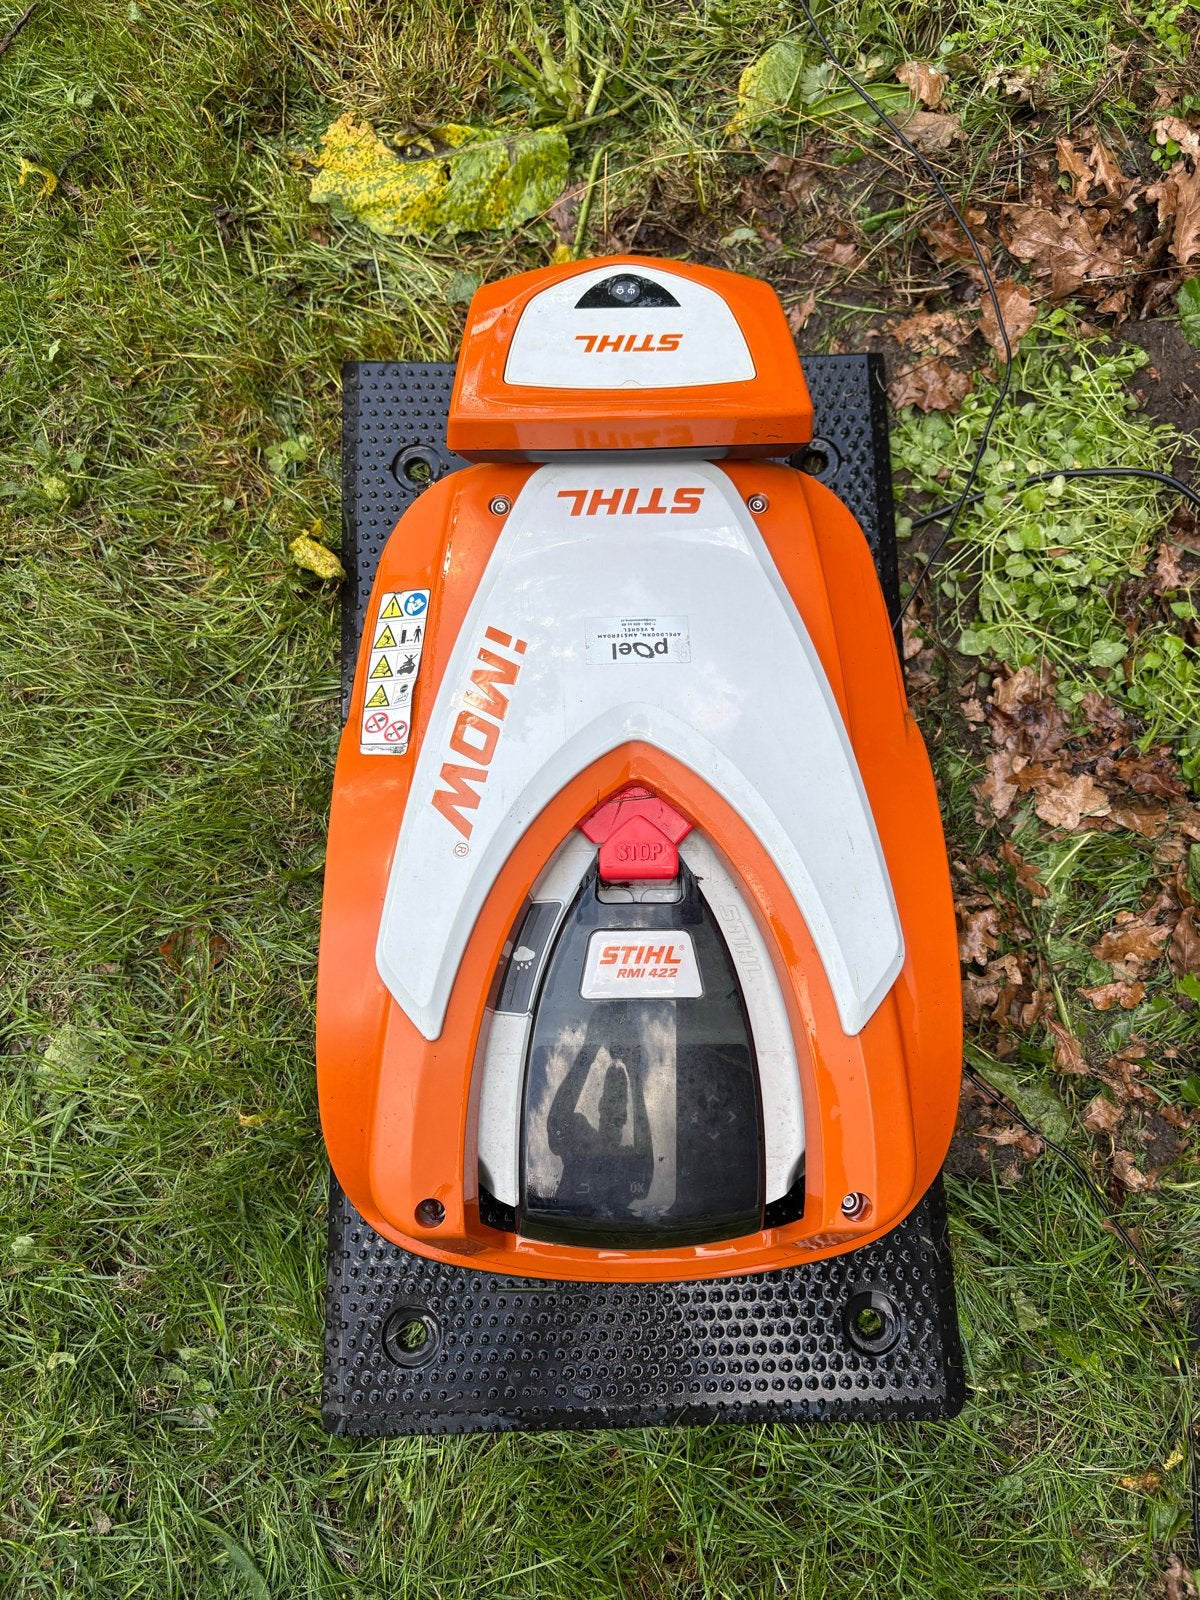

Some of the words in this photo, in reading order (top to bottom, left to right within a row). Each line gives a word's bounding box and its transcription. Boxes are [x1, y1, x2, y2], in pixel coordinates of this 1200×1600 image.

[575, 335, 684, 353] STIHL
[557, 488, 705, 516] STIHL
[612, 638, 668, 660] poel
[617, 843, 662, 861] STOP
[719, 904, 762, 982] STIHL
[617, 968, 646, 978] RMI
[648, 968, 678, 978] 422
